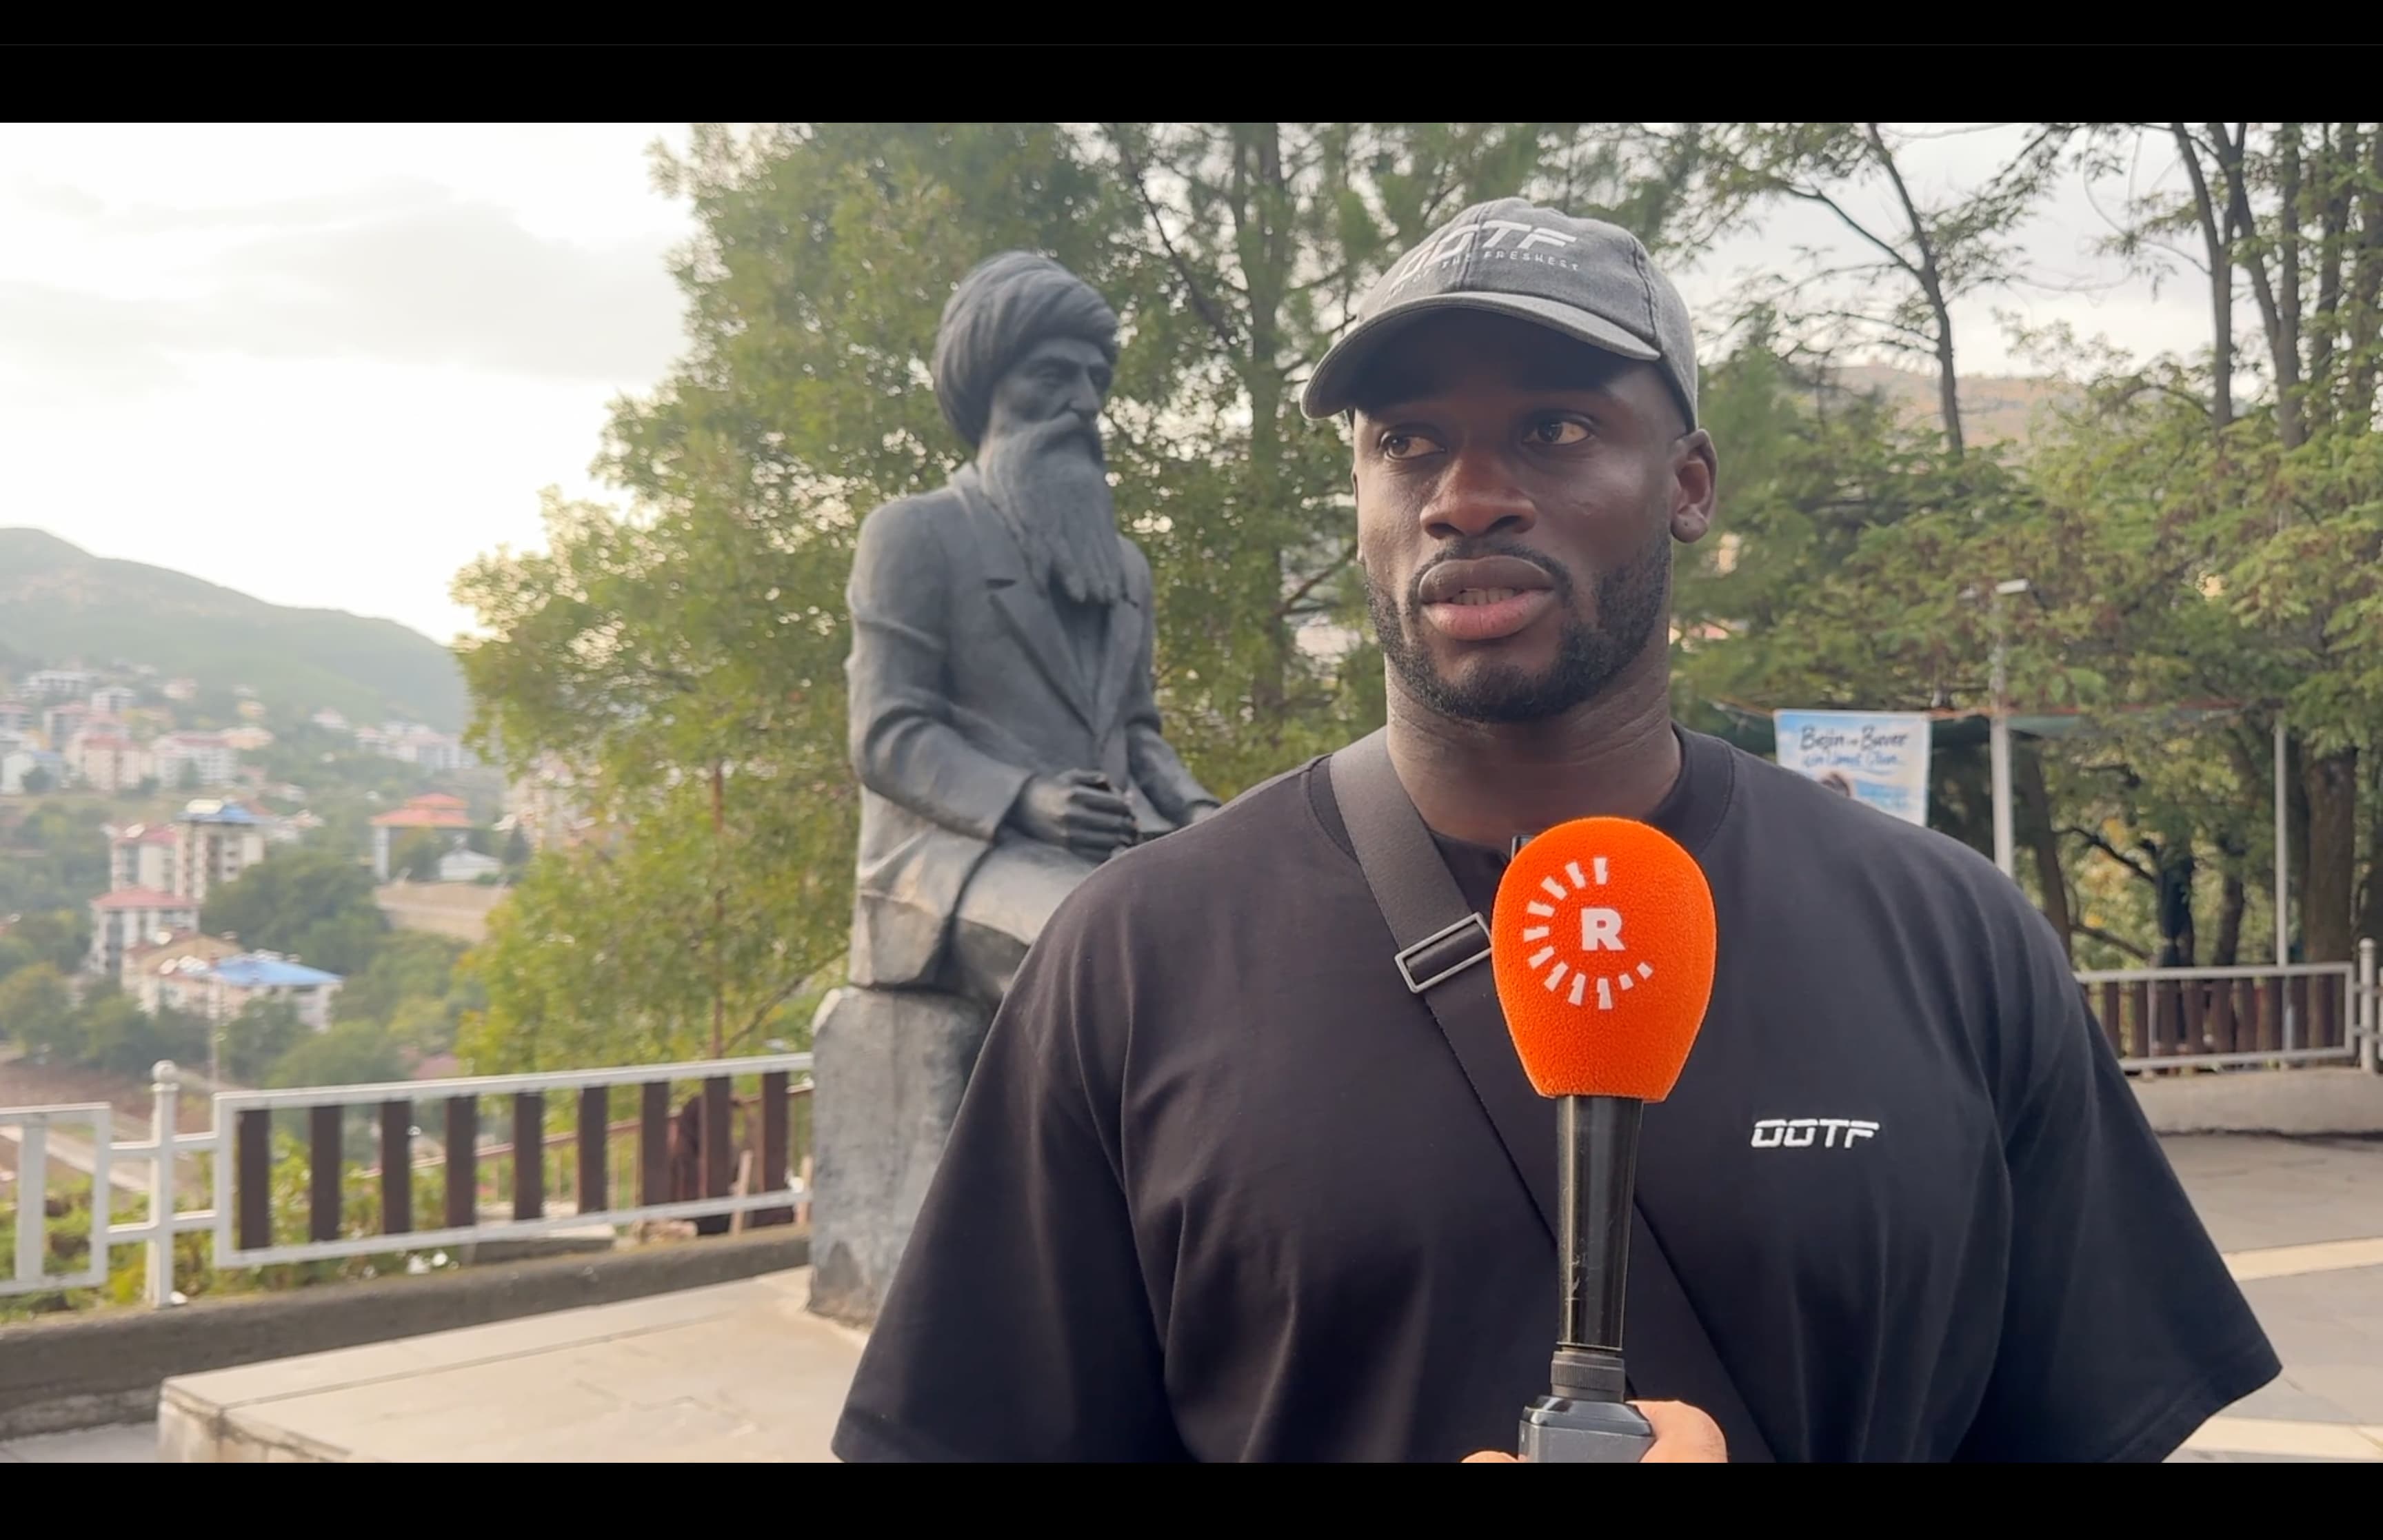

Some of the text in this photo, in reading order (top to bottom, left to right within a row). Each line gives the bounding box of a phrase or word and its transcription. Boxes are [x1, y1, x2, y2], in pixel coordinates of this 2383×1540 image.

[1483, 250, 1579, 272] FRESHEST
[1581, 907, 1626, 951] R
[1751, 1118, 1880, 1148] OOTF
